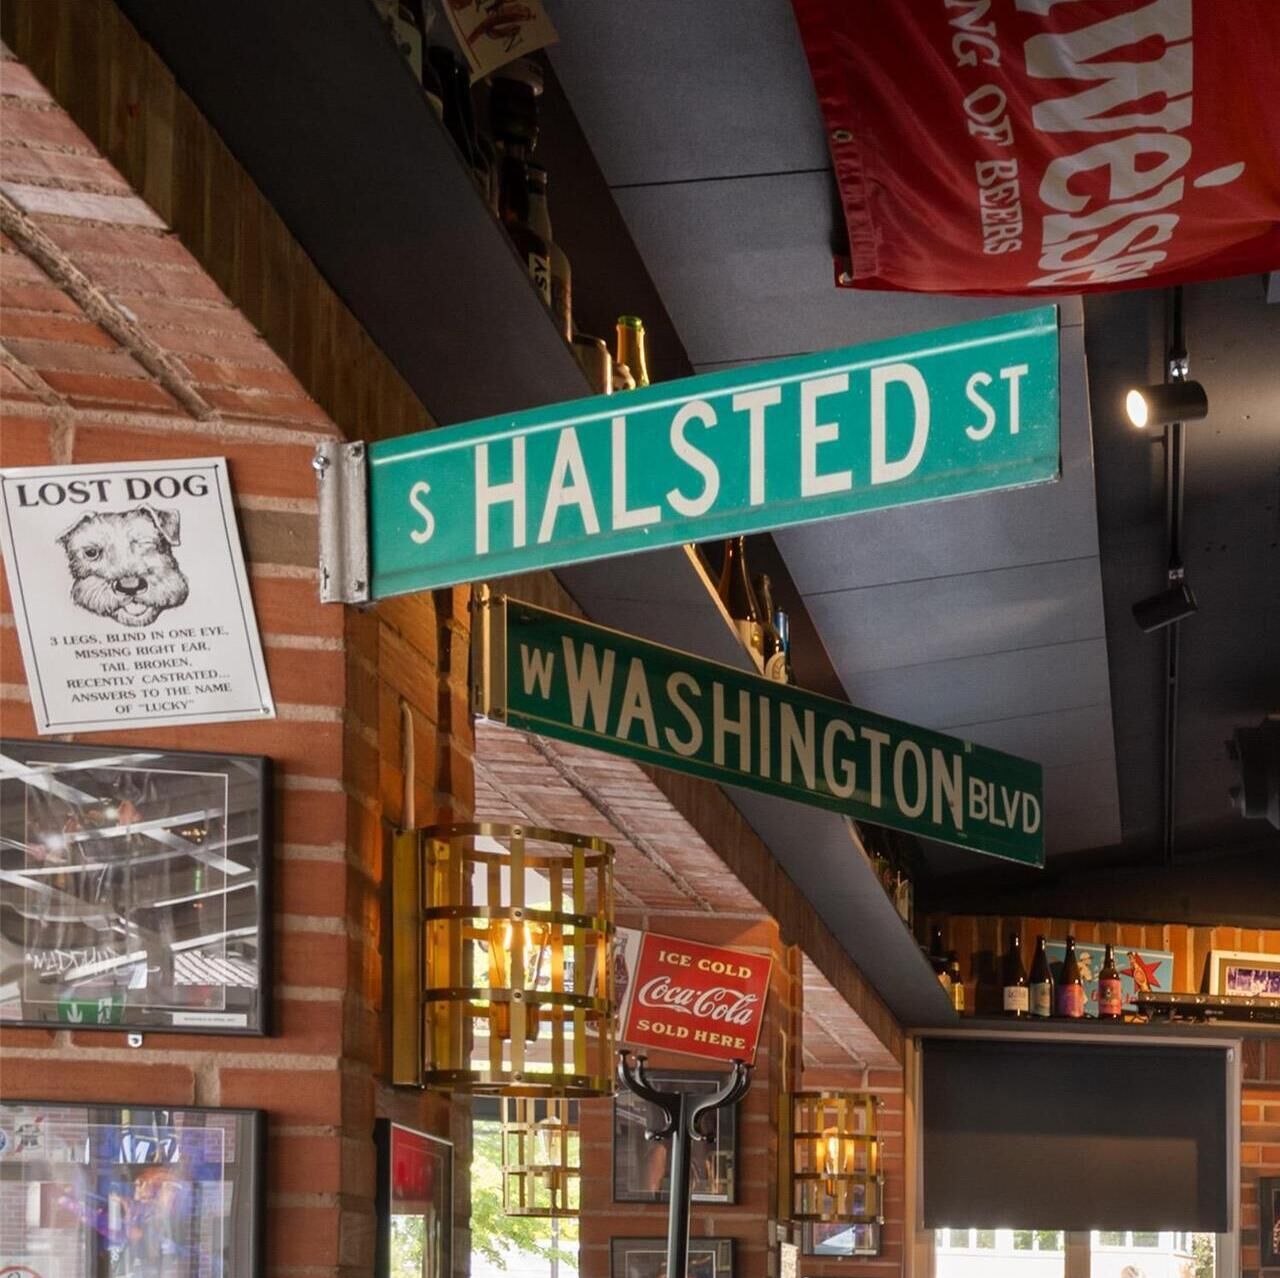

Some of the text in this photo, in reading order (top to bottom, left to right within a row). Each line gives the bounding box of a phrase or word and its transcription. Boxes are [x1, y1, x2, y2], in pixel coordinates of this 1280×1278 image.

[963, 84, 1013, 147] OF
[975, 158, 1022, 256] BEERS
[409, 362, 1029, 555] S HALSTED ST
[17, 474, 209, 507] LOST DOG
[50, 637, 58, 646] 3
[107, 632, 146, 643] BLIND
[151, 629, 164, 640] IN
[169, 628, 196, 638] ONE
[75, 648, 131, 659] MISSING
[136, 644, 176, 655] RIGHT
[100, 662, 130, 672] TAIL
[66, 676, 135, 689] RECENTLY
[72, 682, 232, 702] ANSWERS TO THE NAME
[115, 700, 195, 714] OF "LUCKY"
[520, 636, 1040, 835] W WASHINGTON BLVD
[658, 951, 752, 979] ICE COLD
[637, 1019, 746, 1049] SOLD HERE
